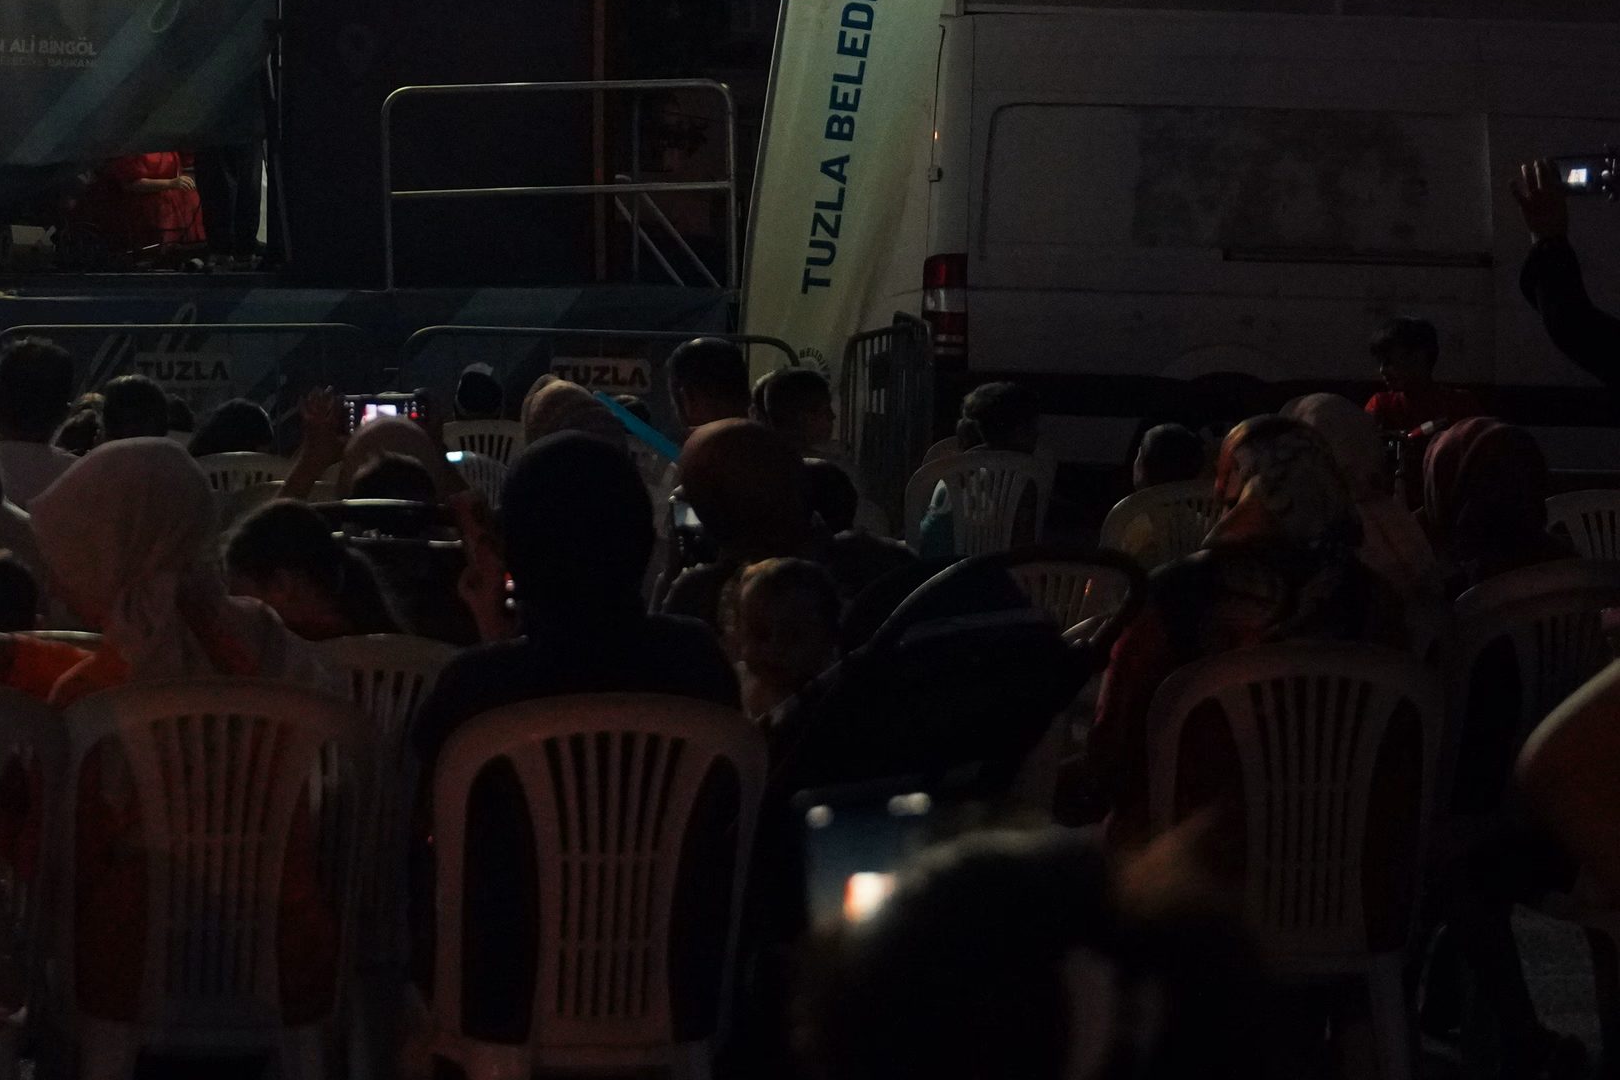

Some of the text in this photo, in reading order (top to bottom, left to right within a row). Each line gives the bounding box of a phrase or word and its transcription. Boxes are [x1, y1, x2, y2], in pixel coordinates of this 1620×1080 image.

[9, 34, 36, 53] ALİ
[38, 35, 98, 56] BİNGÖL
[801, 154, 851, 295] TUZLA
[137, 360, 229, 381] TUZLA
[552, 364, 648, 387] TUZLA
